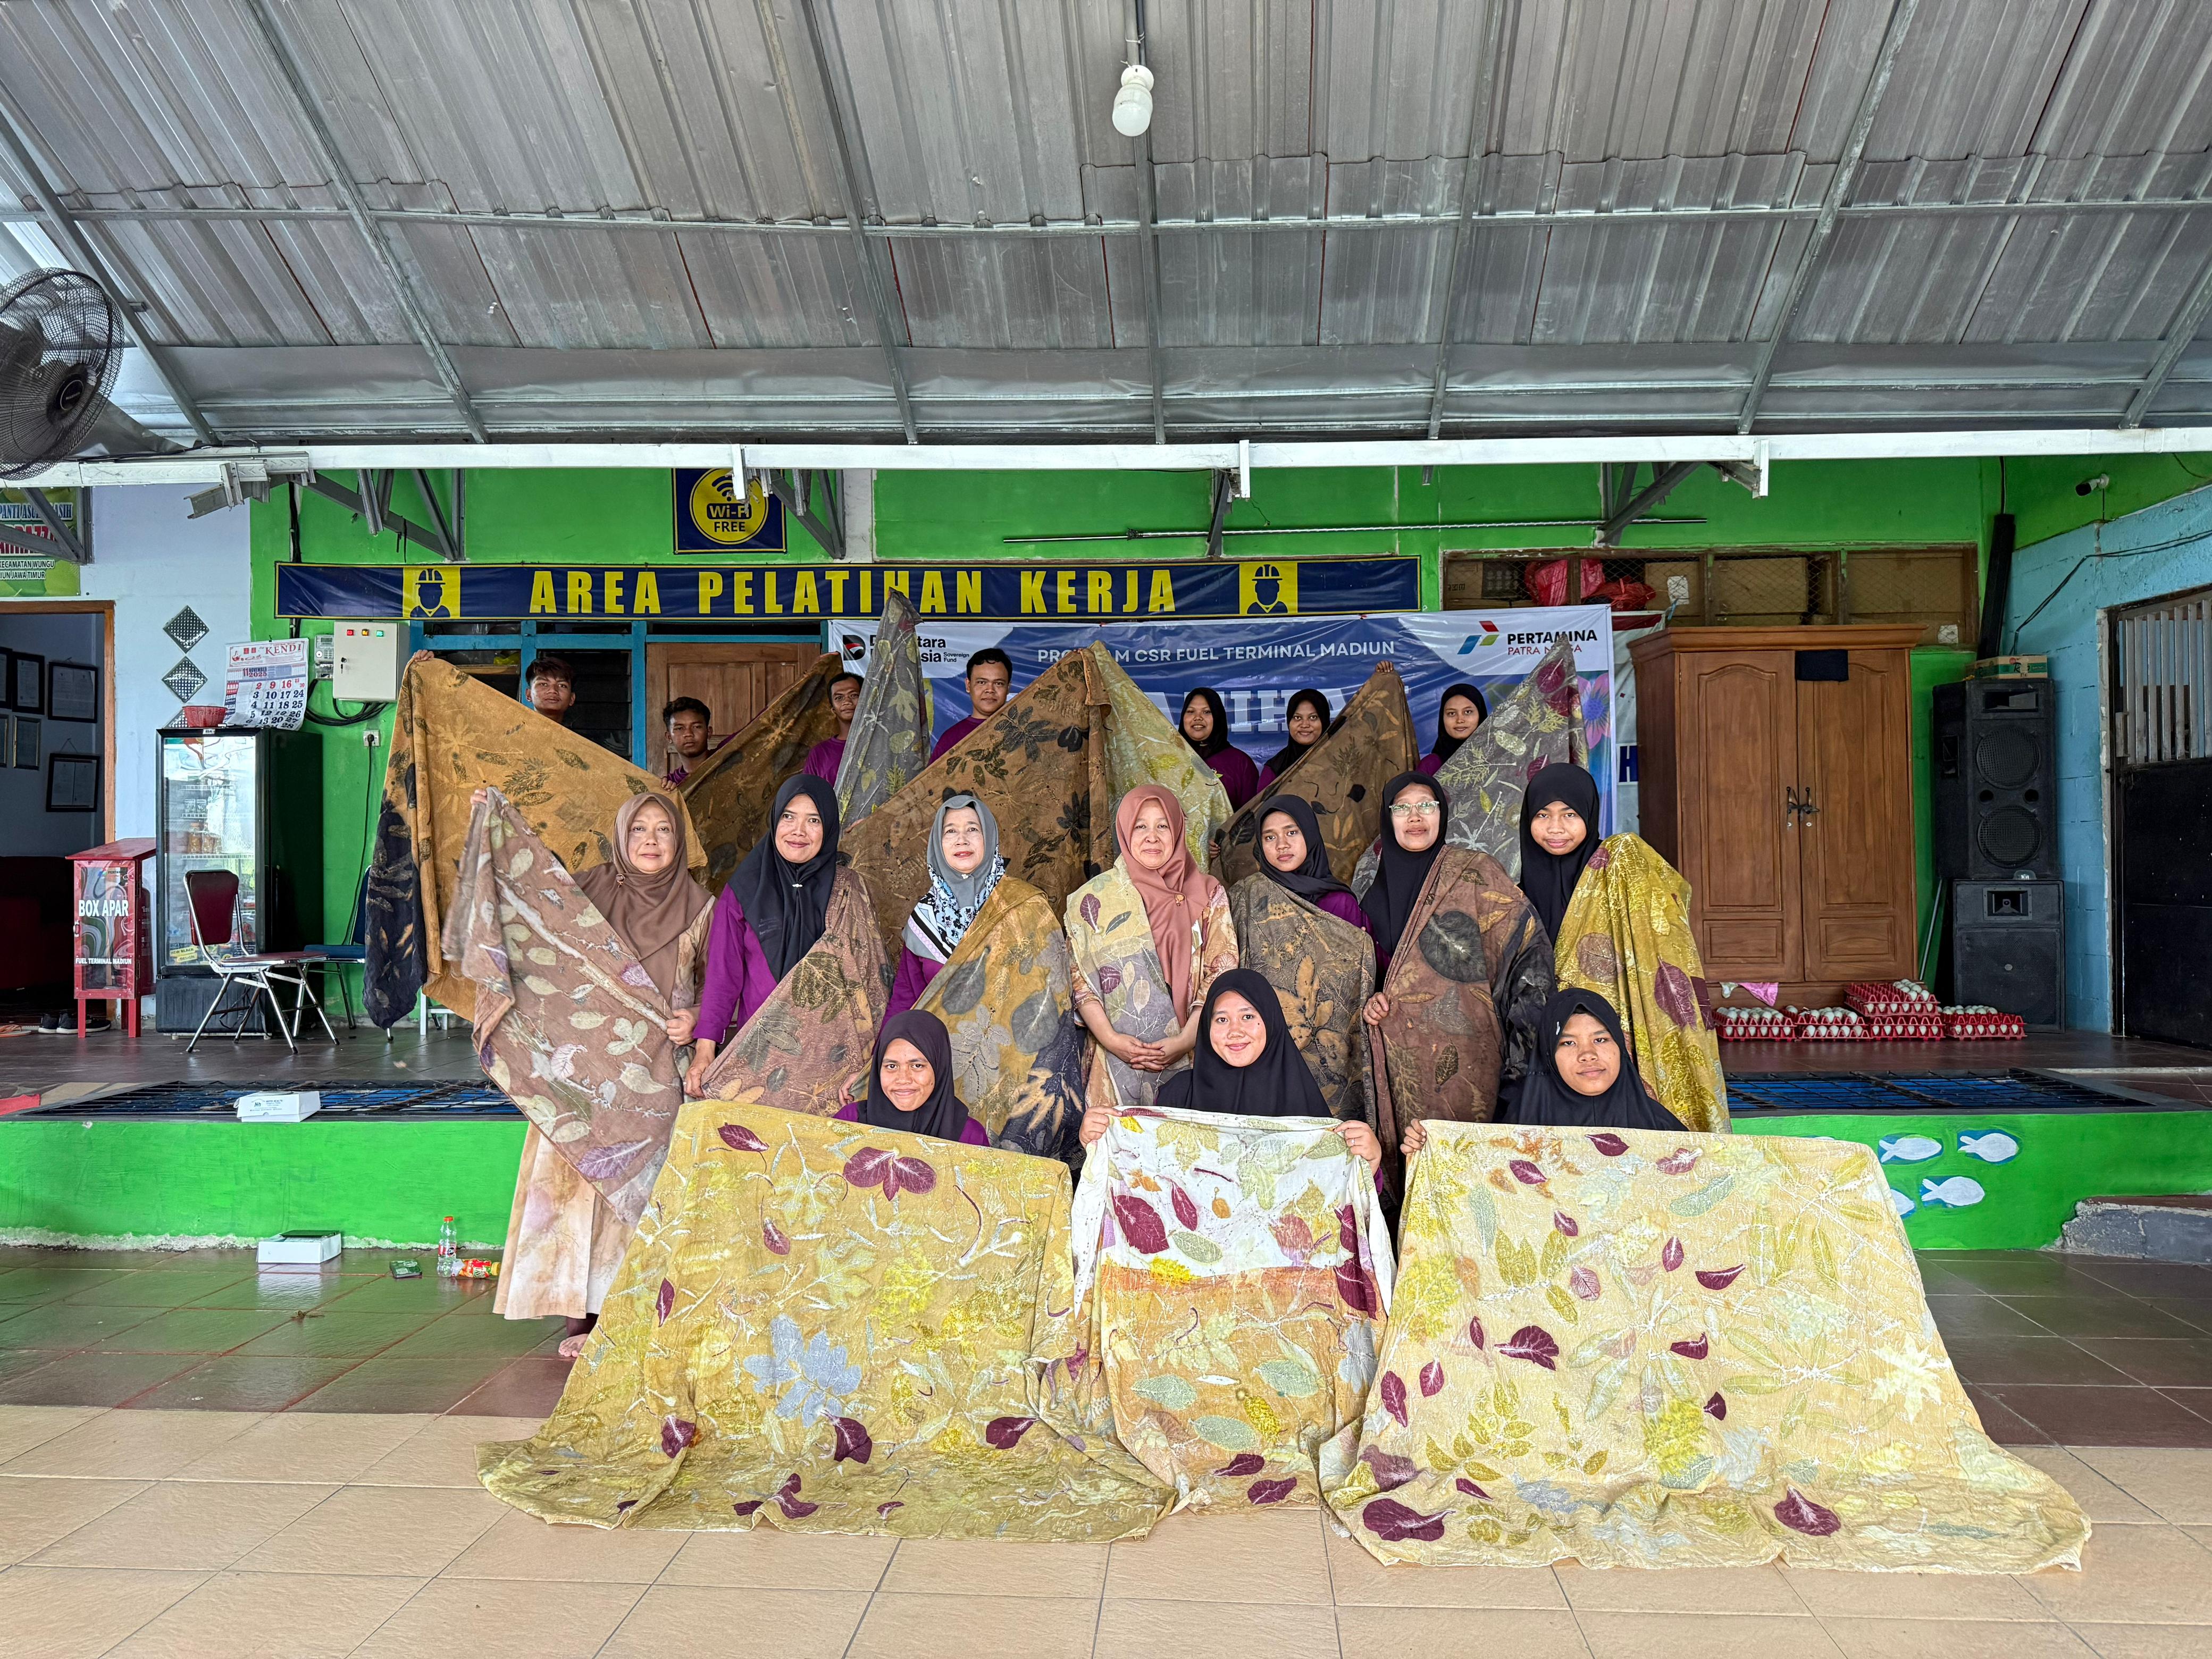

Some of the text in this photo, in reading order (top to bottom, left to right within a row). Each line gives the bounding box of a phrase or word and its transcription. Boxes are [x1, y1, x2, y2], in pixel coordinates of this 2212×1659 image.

[709, 505, 749, 518] Wi-Fi
[714, 522, 745, 532] FREE
[530, 569, 1176, 614] AREA PELATIHAN KERJA
[265, 644, 301, 656] KENDI
[1135, 649, 1171, 662] CSR
[1176, 647, 1219, 660] FUEL
[1223, 643, 1316, 660] TERMINAL
[1320, 641, 1394, 656] MADIUN
[1508, 647, 1540, 655] PATRA
[242, 668, 249, 677] 11
[282, 680, 292, 688] 16
[293, 689, 304, 698] 24
[79, 900, 129, 917] BOX APAR
